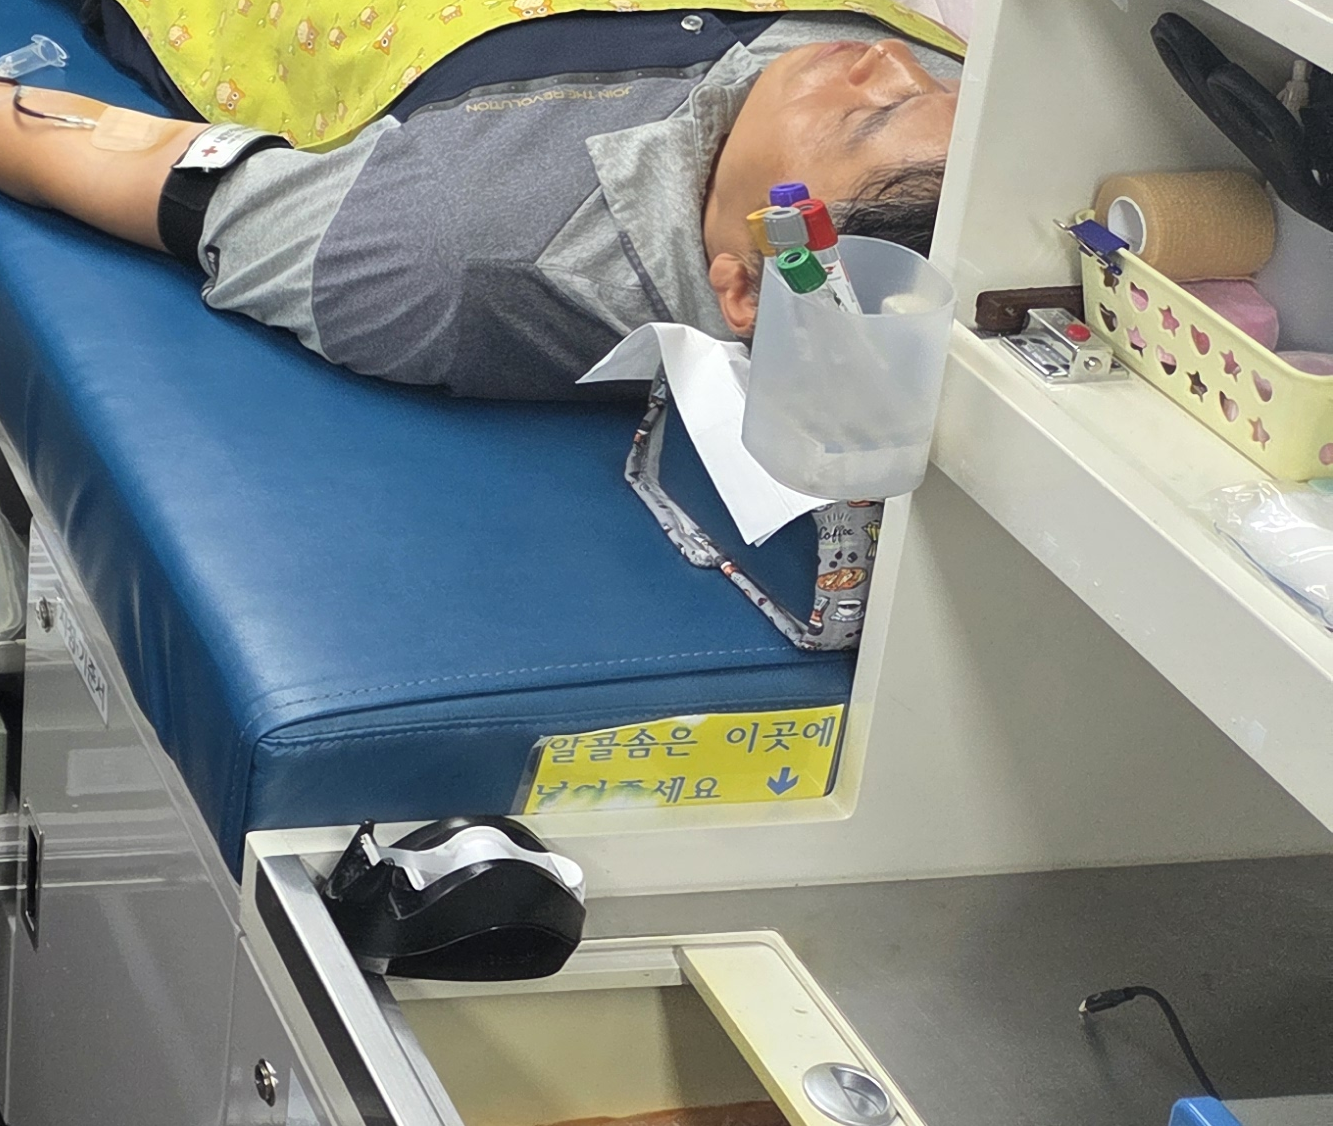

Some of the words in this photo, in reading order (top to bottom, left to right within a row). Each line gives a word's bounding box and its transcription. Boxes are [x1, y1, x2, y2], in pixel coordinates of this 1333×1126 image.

[819, 526, 855, 543] Coffee
[548, 727, 699, 764] 알콜솜은
[726, 715, 837, 753] 이곳에
